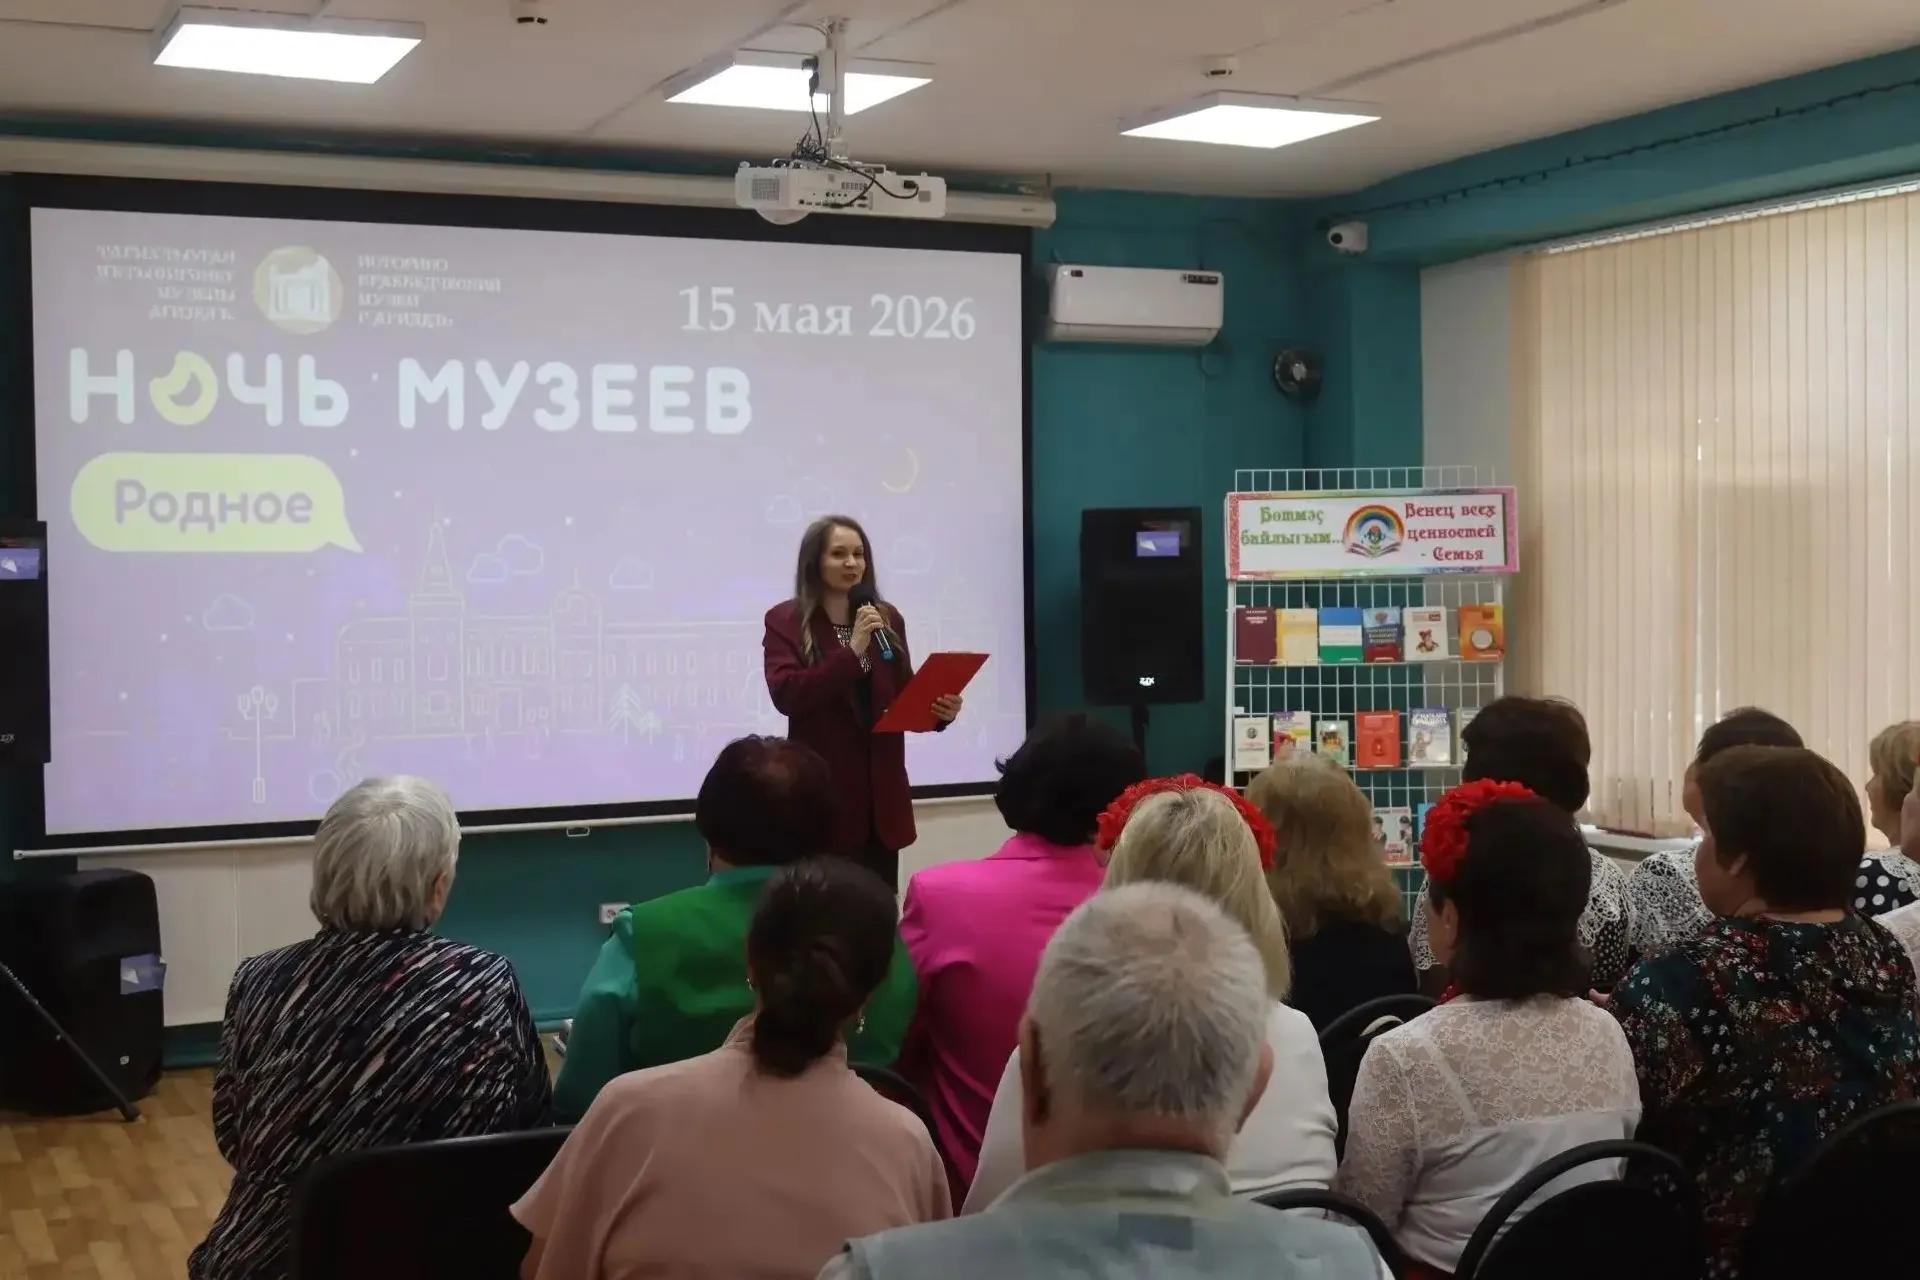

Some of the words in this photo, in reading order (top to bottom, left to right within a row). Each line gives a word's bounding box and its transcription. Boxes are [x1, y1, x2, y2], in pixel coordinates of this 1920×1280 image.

[679, 285, 736, 332] 15
[754, 302, 852, 336] мая
[868, 294, 976, 340] 2026
[69, 347, 350, 428] НОЧЬ
[399, 357, 752, 434] МУЗЕЕВ
[114, 478, 314, 534] Родное
[1405, 502, 1455, 519] Венец
[1461, 505, 1496, 518] всех
[1407, 524, 1496, 542] ценностей
[1433, 546, 1484, 561] Семья
